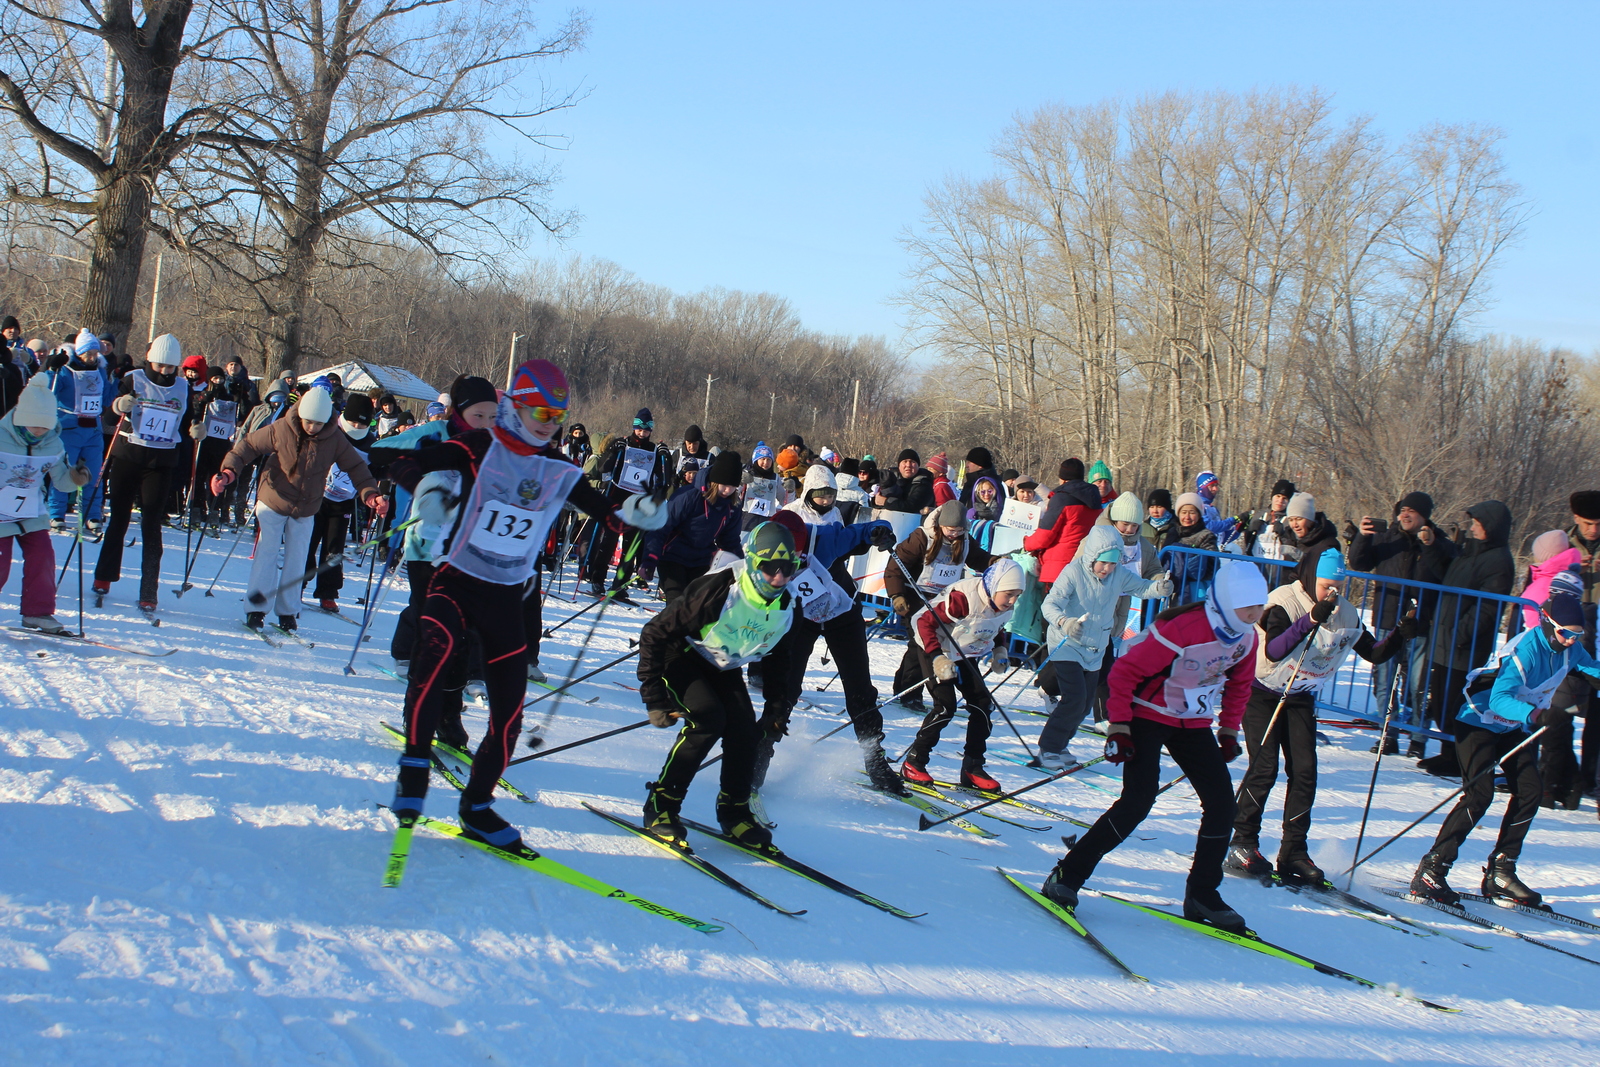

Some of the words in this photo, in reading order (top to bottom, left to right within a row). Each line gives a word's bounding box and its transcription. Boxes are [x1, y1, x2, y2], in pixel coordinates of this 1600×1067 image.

[84, 400, 99, 411] 125
[145, 417, 168, 433] 4/1
[214, 425, 225, 435] 96
[633, 471, 641, 480] 6
[15, 495, 26, 512] 7
[482, 509, 533, 540] 132
[798, 581, 814, 597] 8
[628, 898, 706, 928] FISCHER
[1214, 929, 1241, 941] FISCHER
